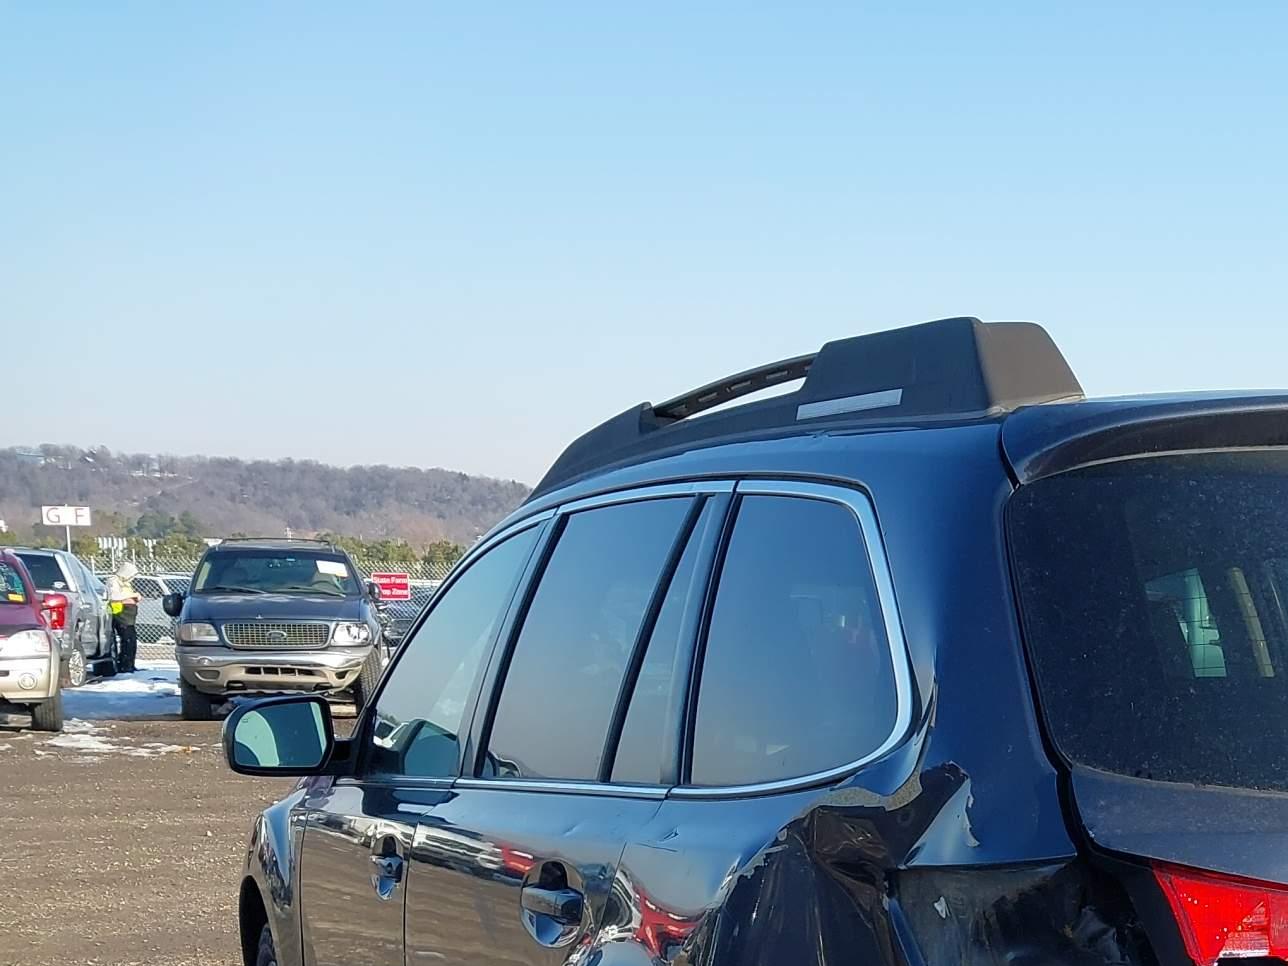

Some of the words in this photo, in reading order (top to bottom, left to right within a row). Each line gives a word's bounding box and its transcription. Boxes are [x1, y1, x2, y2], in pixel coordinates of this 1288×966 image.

[46, 507, 61, 523] G
[75, 507, 85, 524] F
[373, 576, 391, 584] State
[391, 576, 408, 584] Farm
